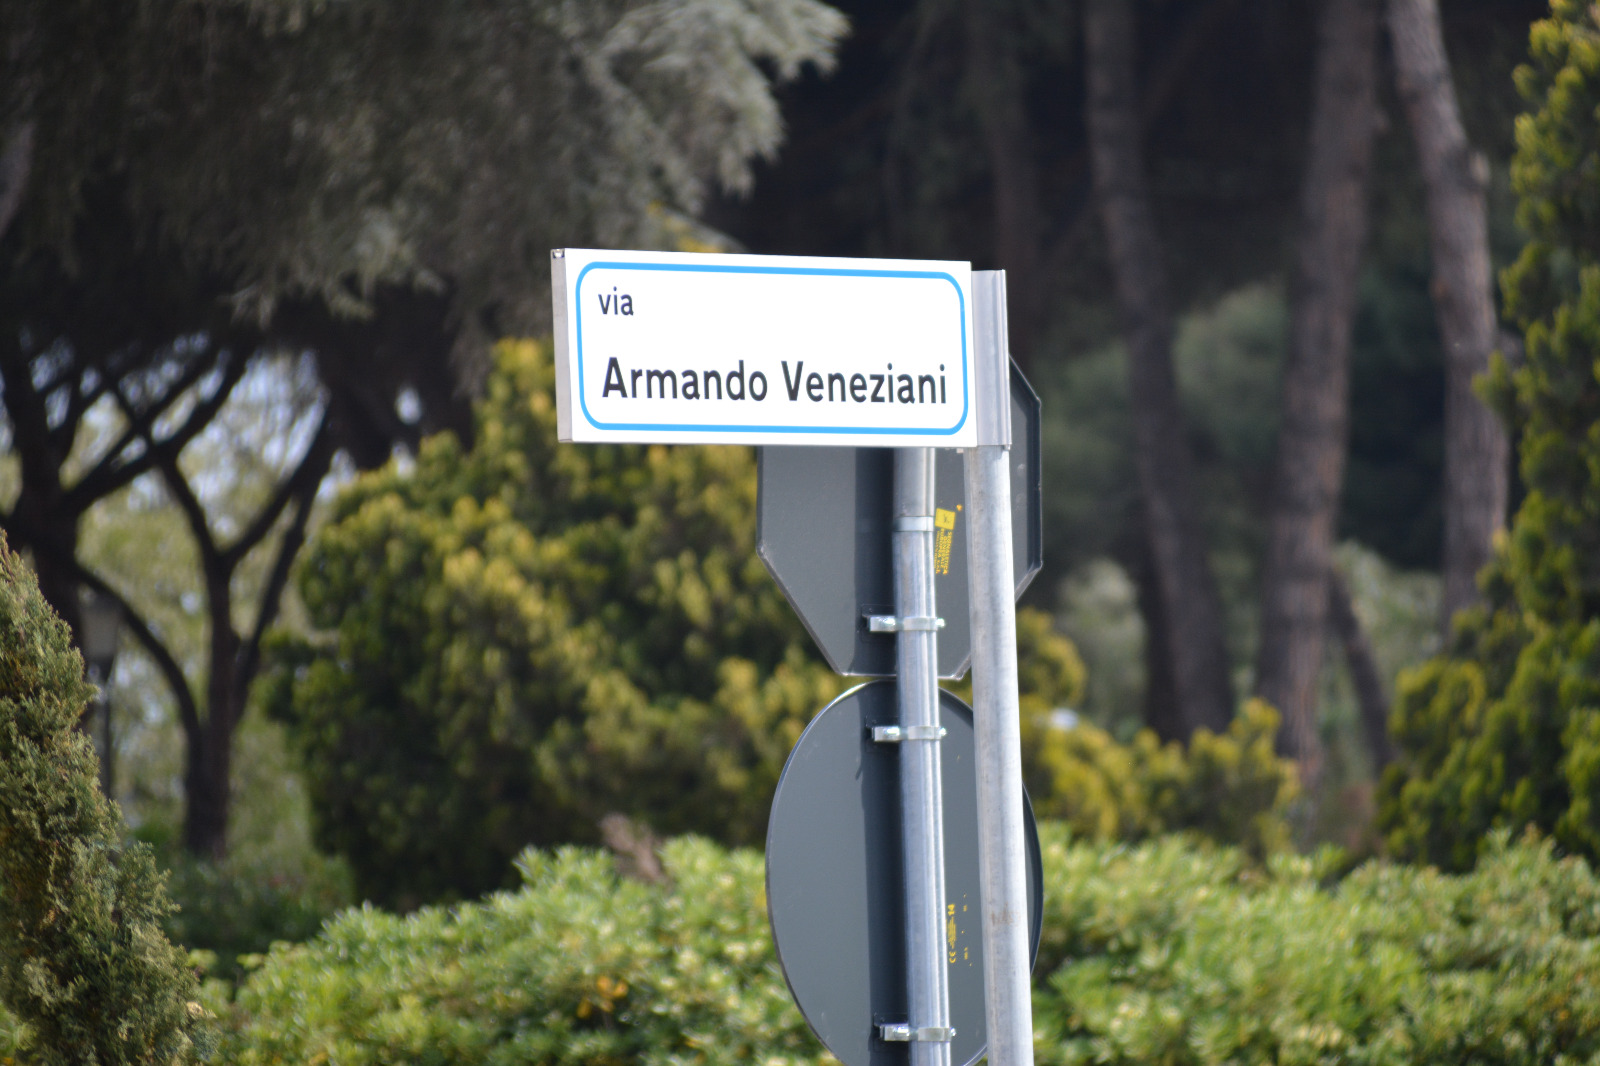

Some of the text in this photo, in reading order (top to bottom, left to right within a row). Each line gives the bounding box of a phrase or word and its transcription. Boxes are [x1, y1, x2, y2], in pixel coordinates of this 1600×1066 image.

[598, 286, 634, 316] via
[602, 356, 947, 405] Armando Veneziani
